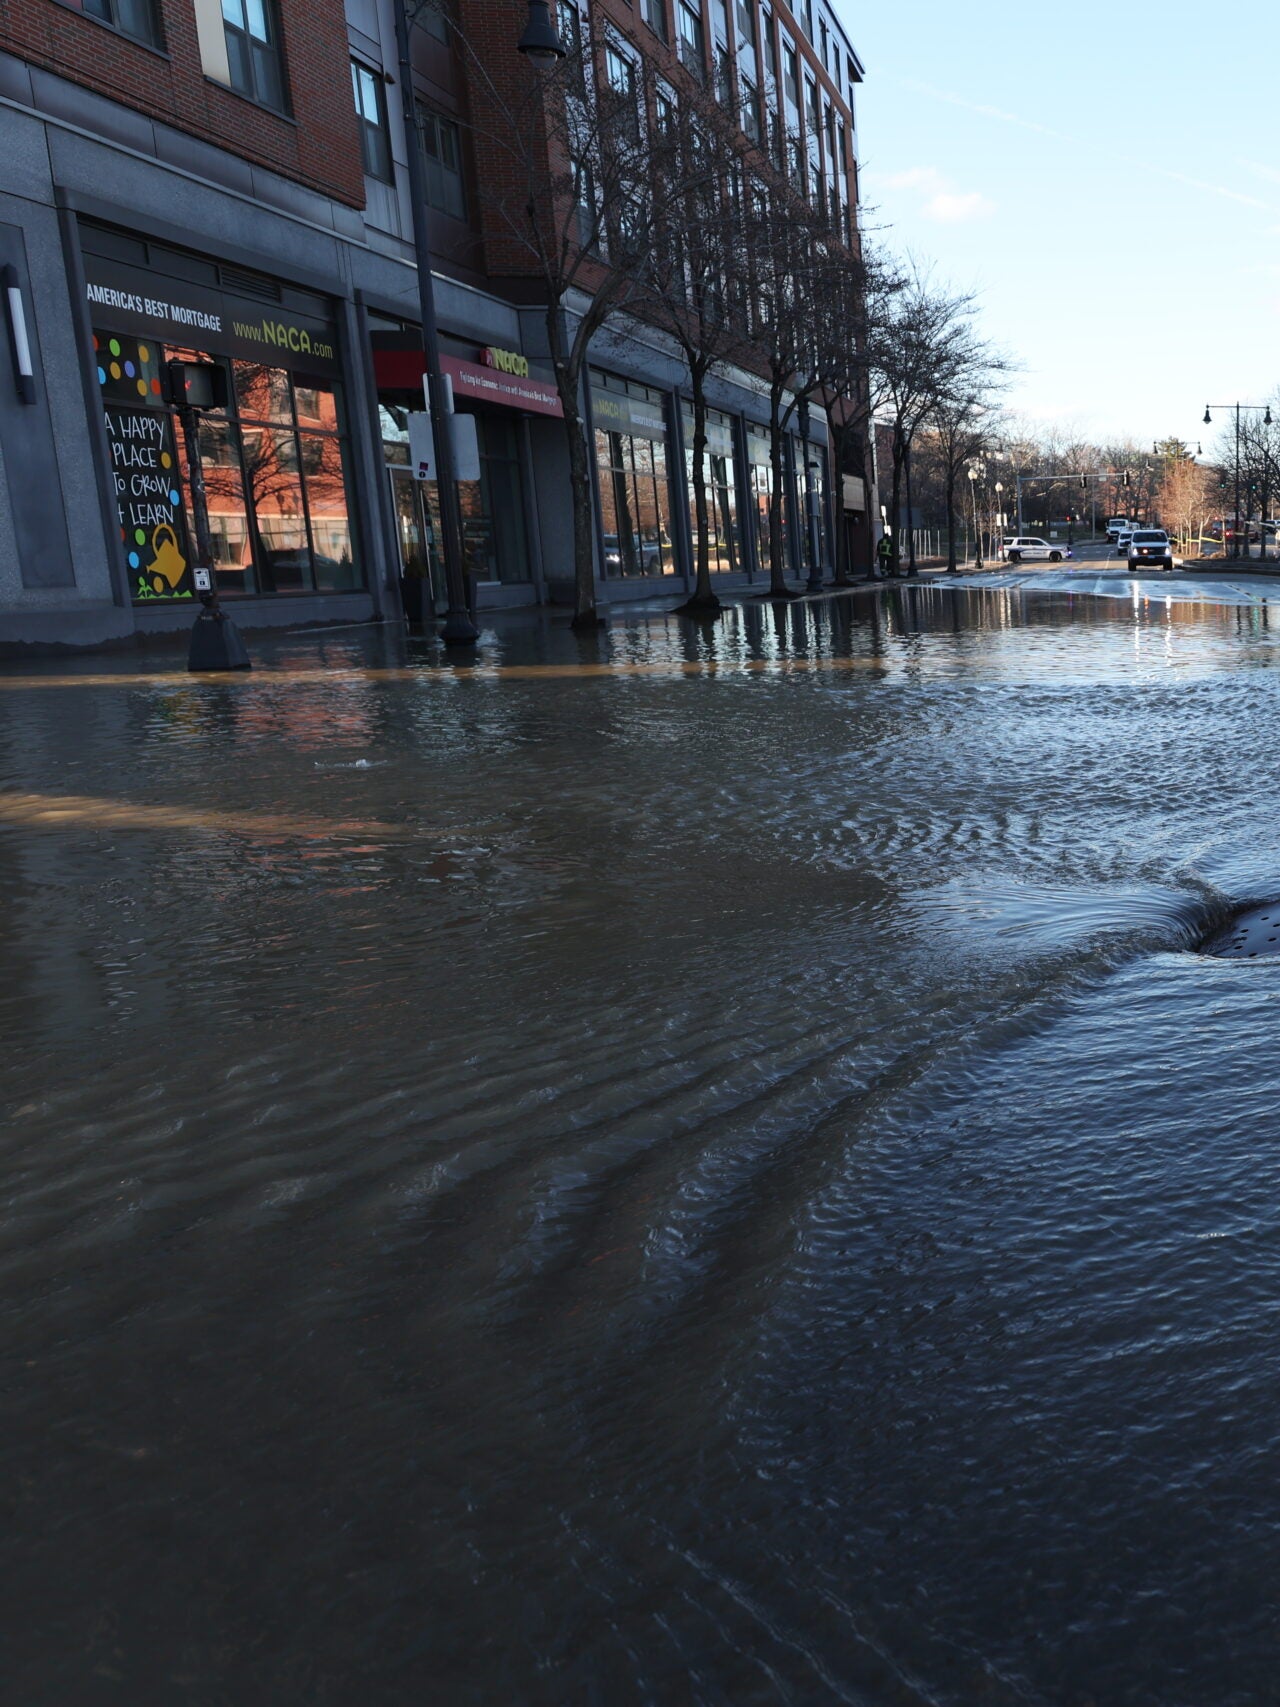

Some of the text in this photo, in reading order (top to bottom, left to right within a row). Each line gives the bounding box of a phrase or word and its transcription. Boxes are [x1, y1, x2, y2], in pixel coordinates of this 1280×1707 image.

[86, 283, 222, 332] AMERICA'S BEST MORTGAGE
[233, 319, 333, 360] www.NACA.com
[487, 346, 529, 379] NACA
[104, 411, 164, 450] A HAPPY
[112, 442, 157, 468] PLACE
[129, 502, 174, 525] LEARN
